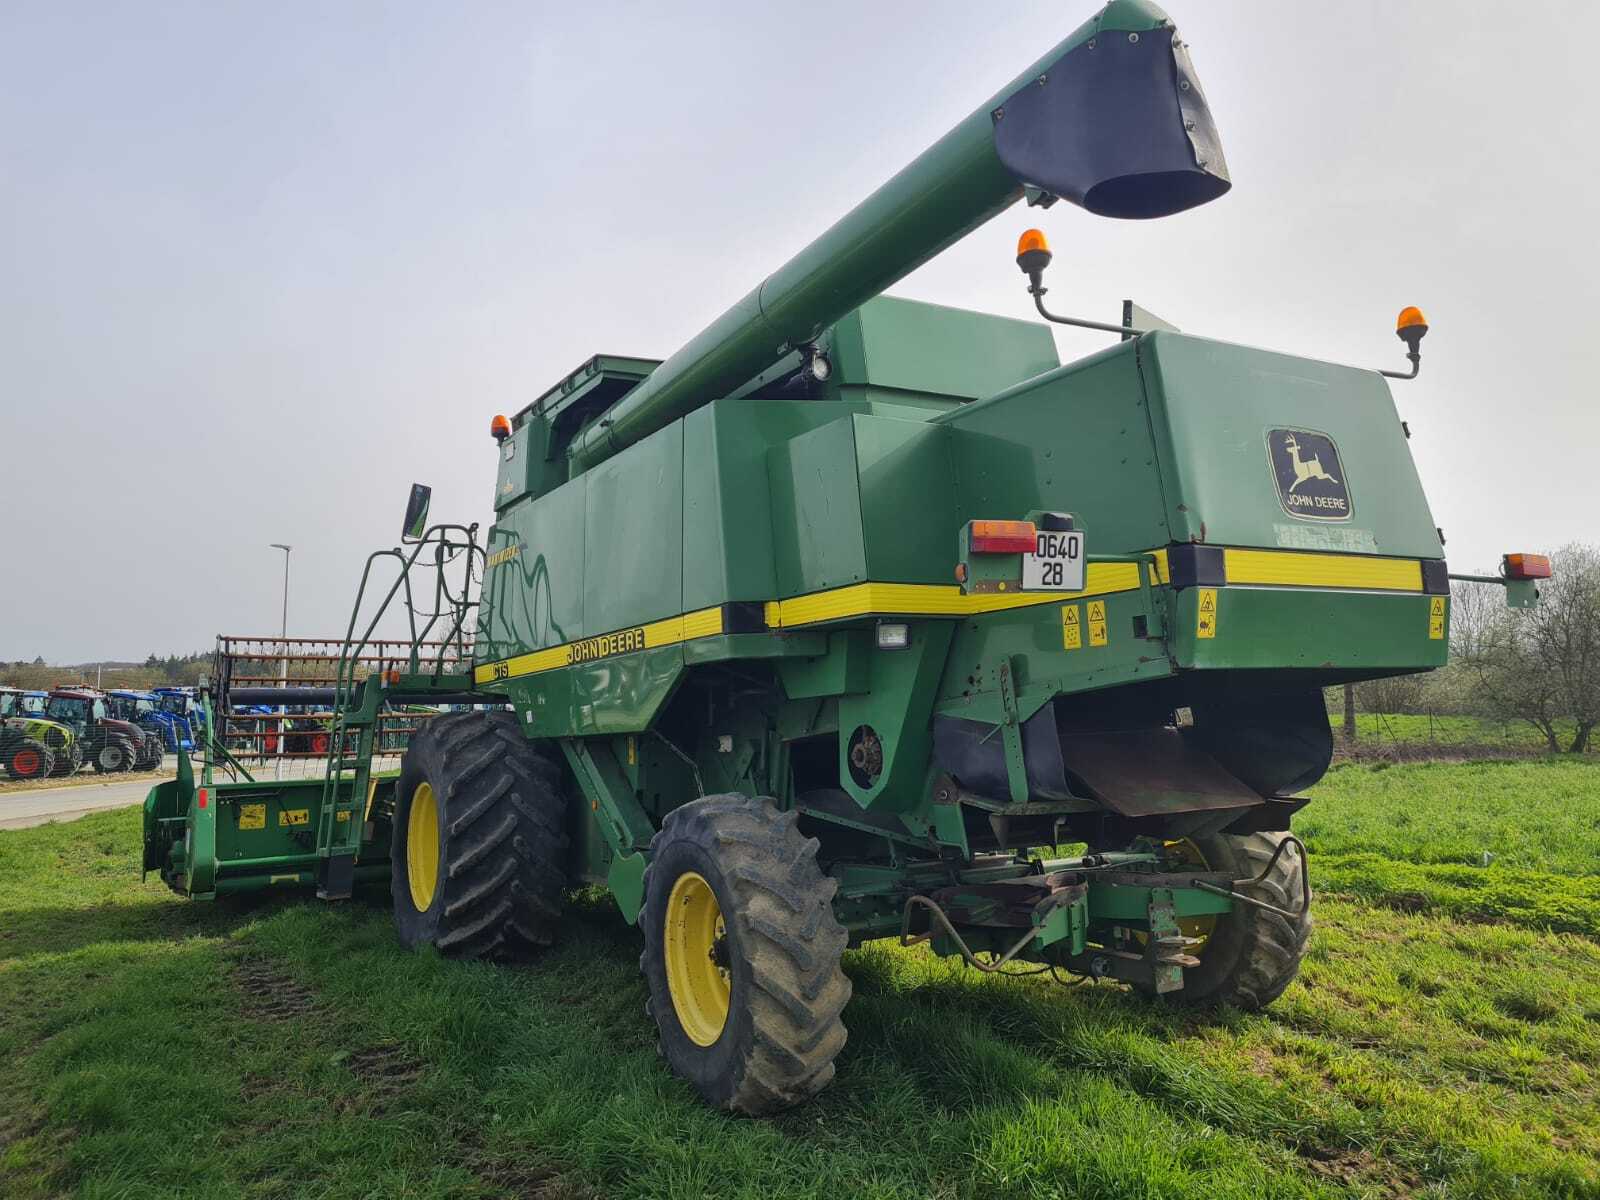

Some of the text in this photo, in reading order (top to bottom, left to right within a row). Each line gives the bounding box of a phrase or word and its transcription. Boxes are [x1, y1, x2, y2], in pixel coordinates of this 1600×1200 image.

[1287, 494, 1347, 510] JOHN DEERE
[1031, 534, 1079, 559] 0640
[1042, 562, 1063, 585] 28
[566, 628, 645, 665] JOHN DEERE
